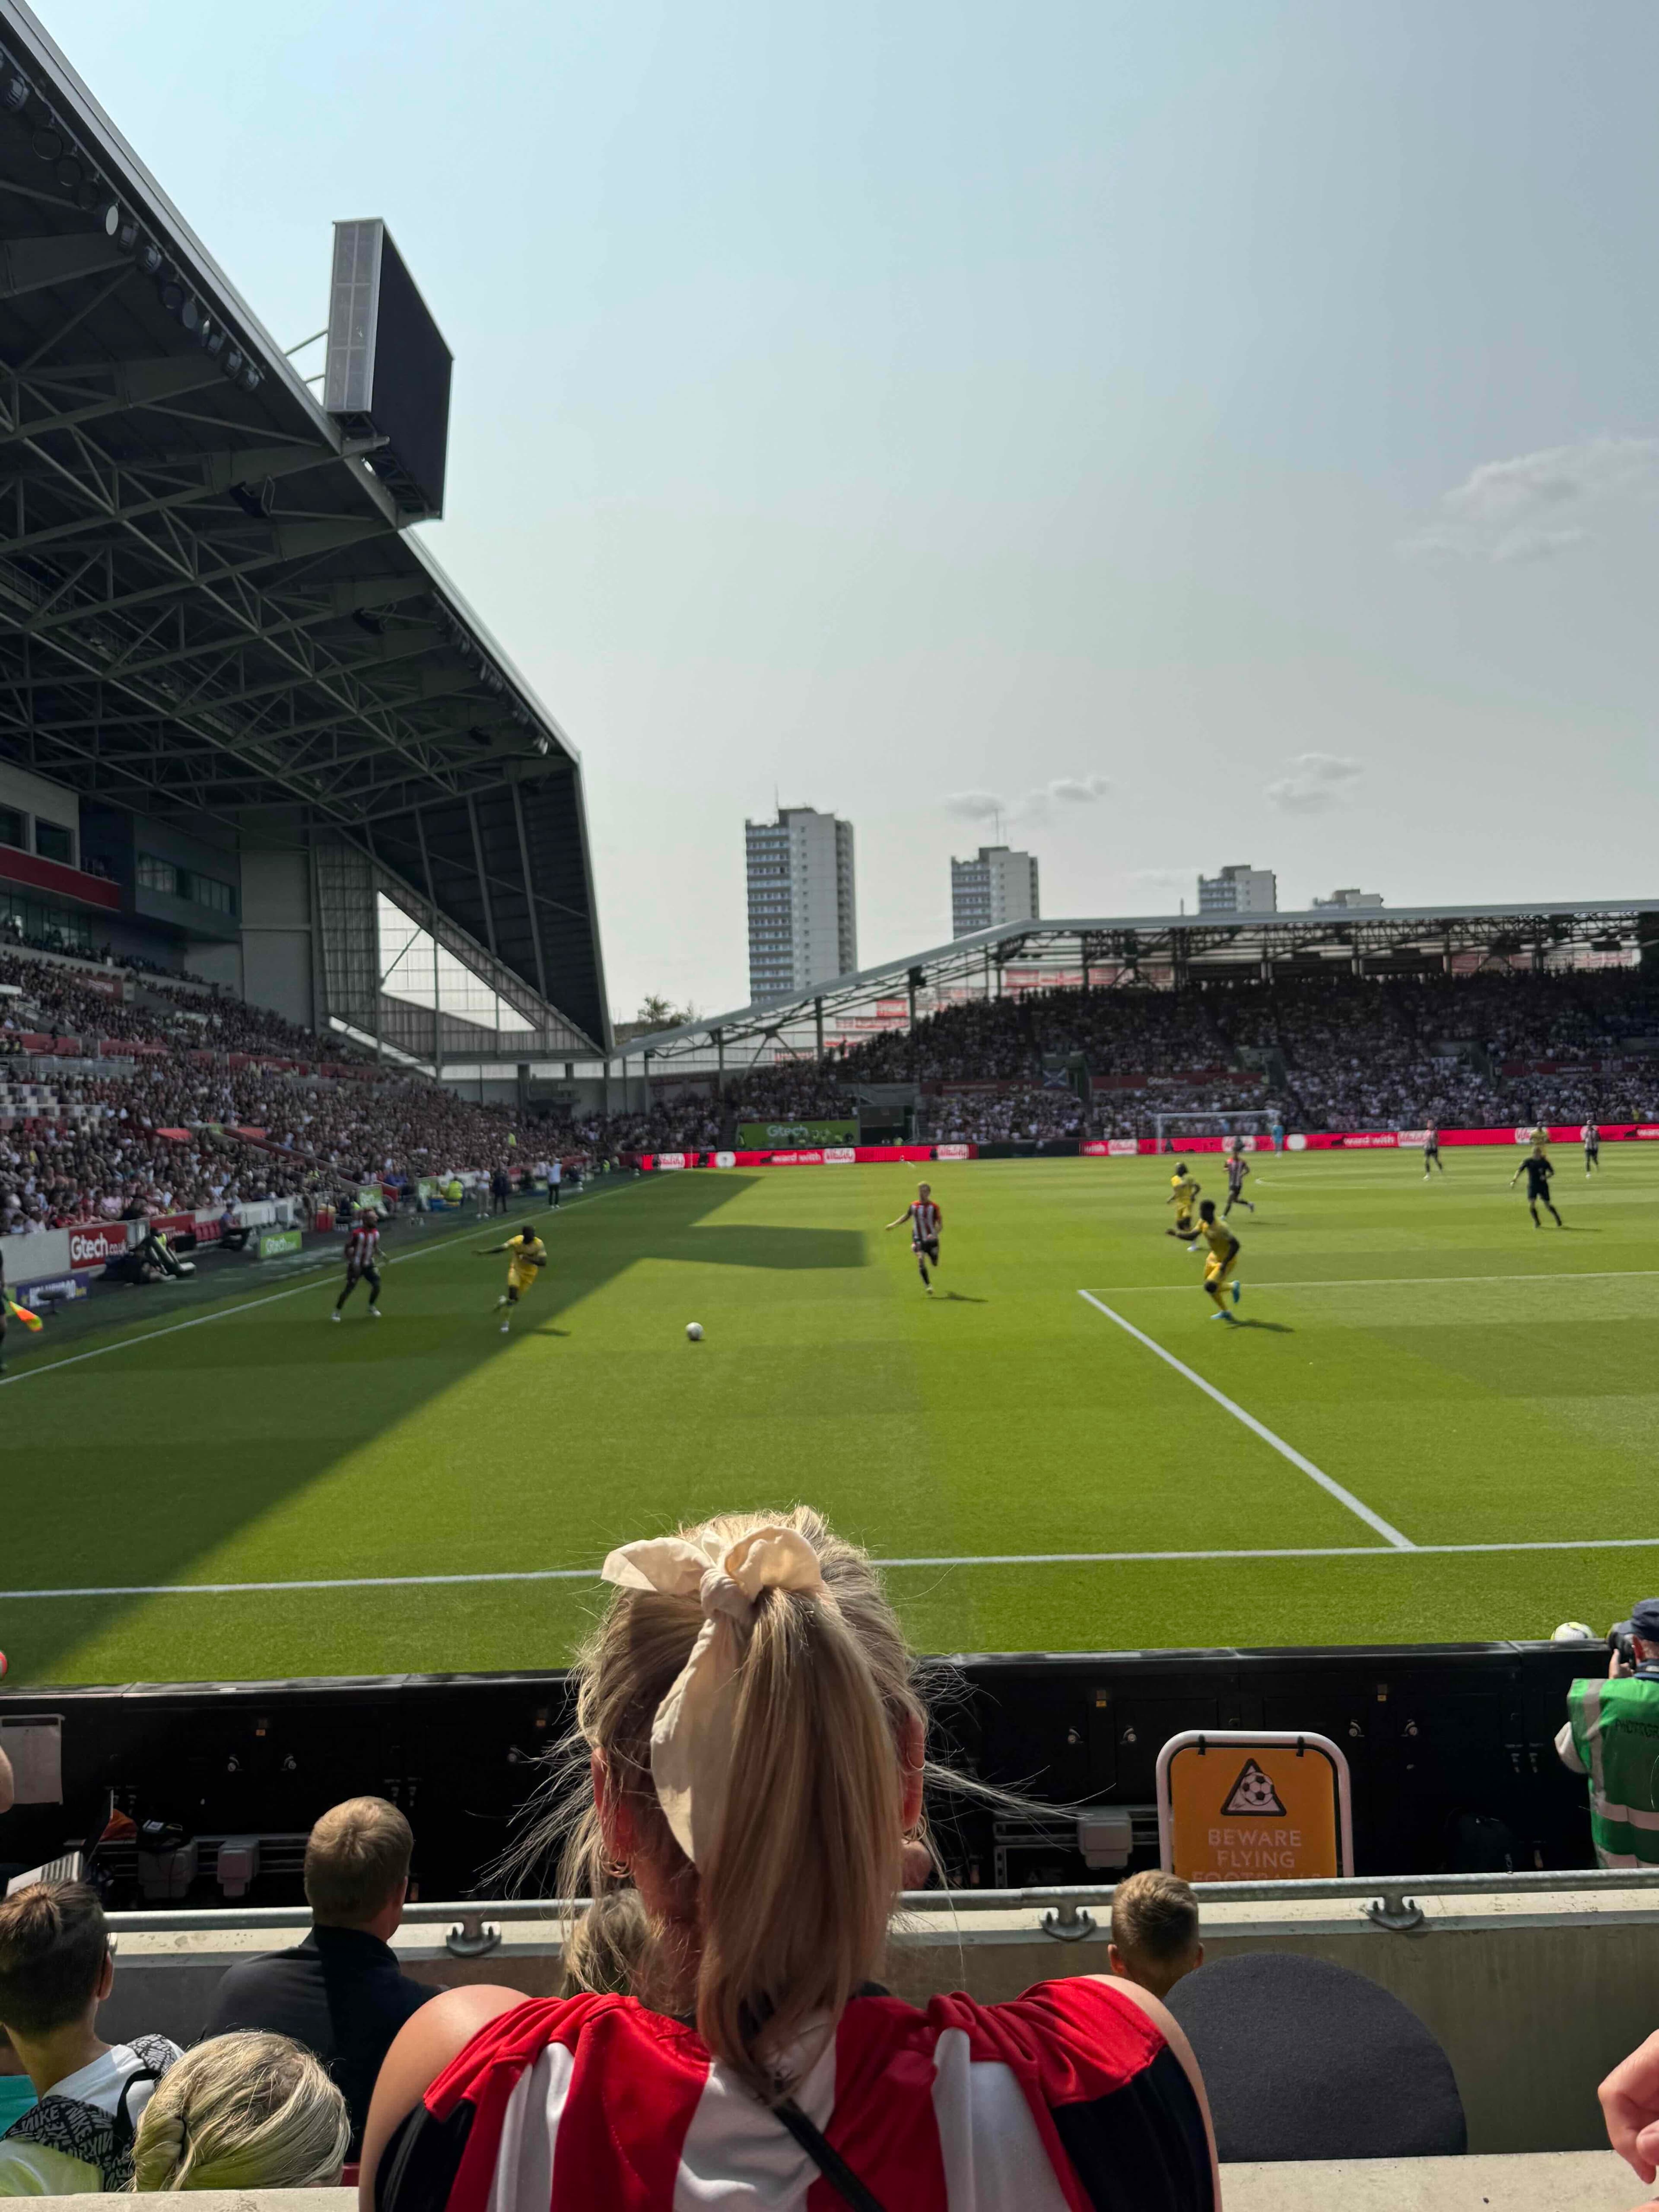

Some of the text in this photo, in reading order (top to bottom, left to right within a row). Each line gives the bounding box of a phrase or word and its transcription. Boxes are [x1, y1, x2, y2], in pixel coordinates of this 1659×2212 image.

[767, 1125, 809, 1137] Gtech
[1208, 1828, 1302, 1847] BEWARE
[1217, 1850, 1295, 1869] FLYING
[22, 2104, 60, 2133] NIKE
[65, 2106, 93, 2144] NIKE
